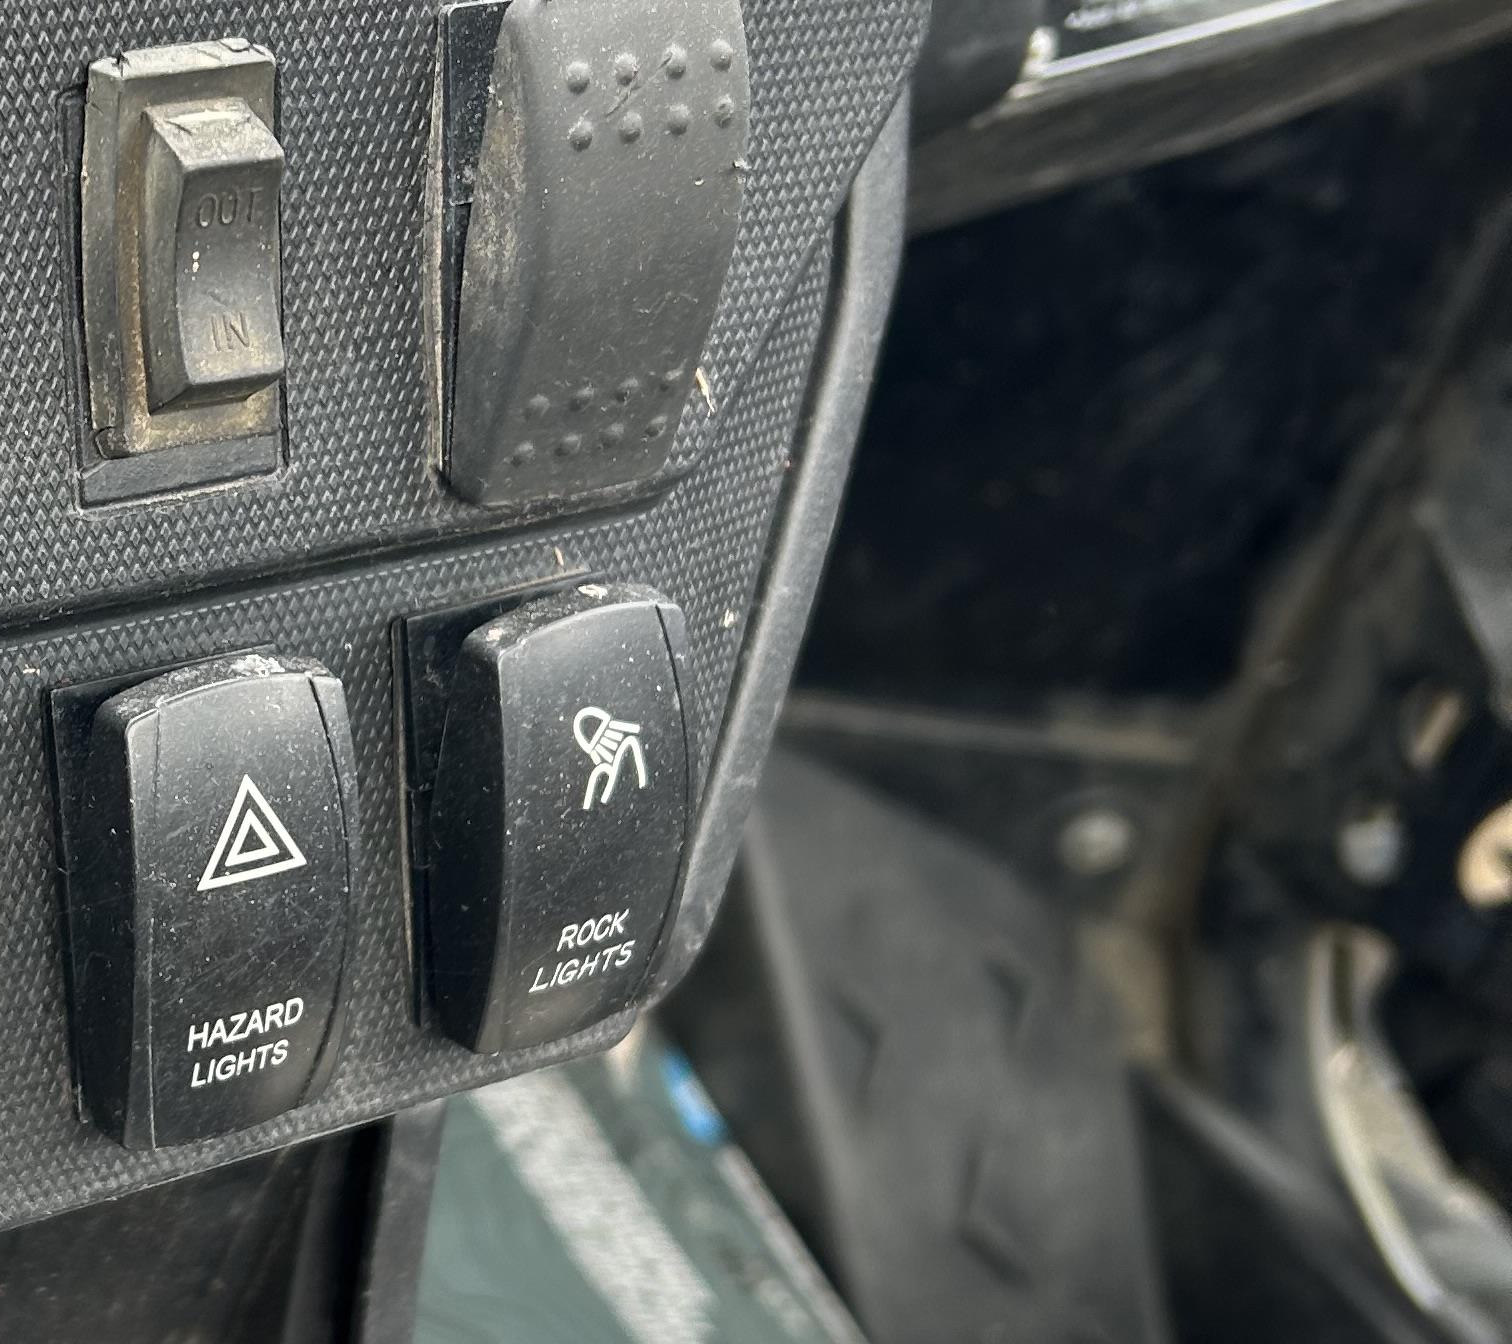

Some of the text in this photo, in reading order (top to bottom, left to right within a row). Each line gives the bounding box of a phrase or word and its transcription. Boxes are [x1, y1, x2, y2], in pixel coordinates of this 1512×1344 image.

[195, 186, 264, 229] OUT
[211, 310, 251, 353] IN
[557, 908, 630, 952] ROCK
[528, 940, 636, 993] LIGHTS
[187, 997, 304, 1052] HAZARD
[190, 1039, 289, 1087] LIGHTS
